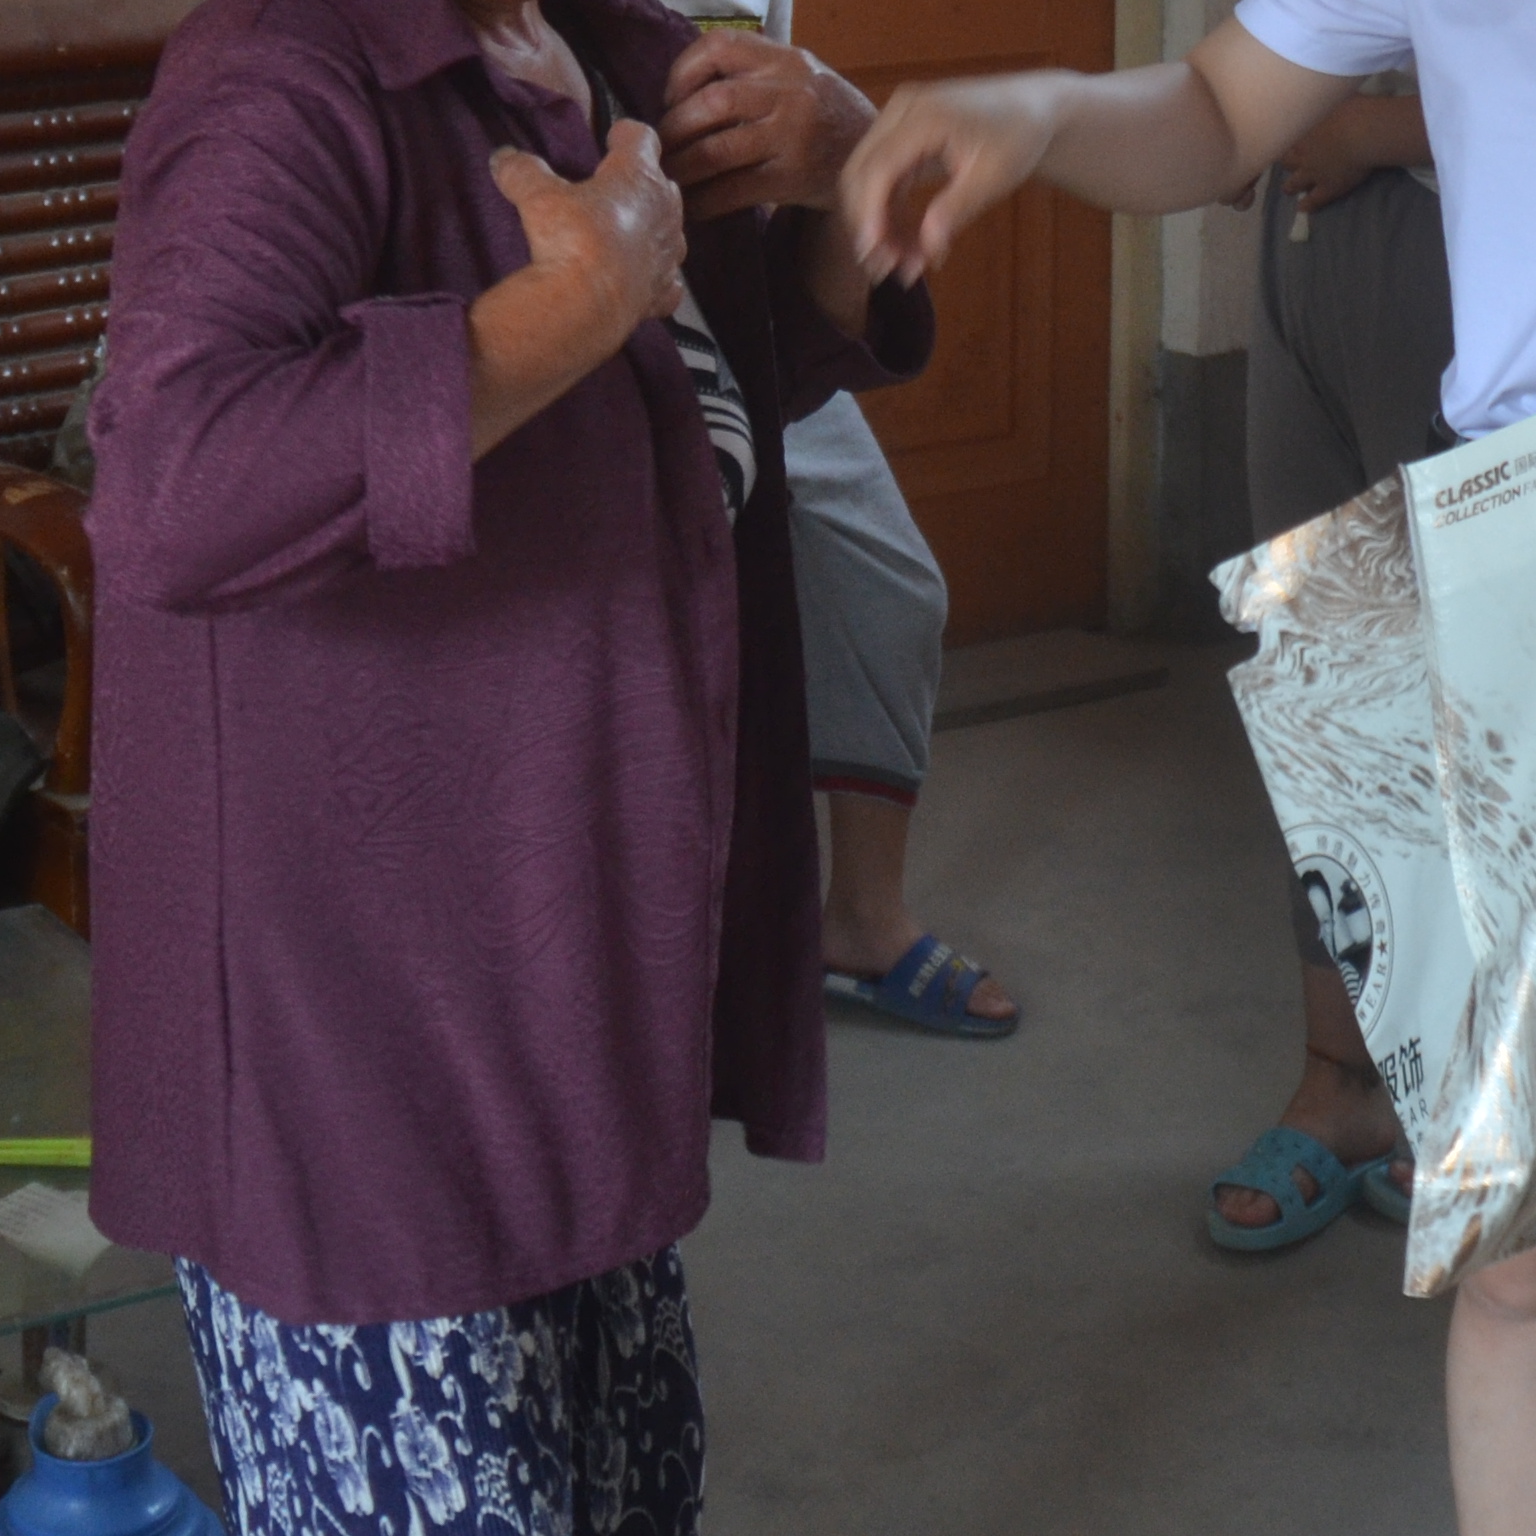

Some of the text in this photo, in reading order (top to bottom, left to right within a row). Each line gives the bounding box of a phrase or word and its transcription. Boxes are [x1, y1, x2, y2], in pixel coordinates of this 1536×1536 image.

[1434, 460, 1512, 509] CLASSIC
[1434, 485, 1522, 529] COLLECTION
[1357, 963, 1387, 1023] WEAR
